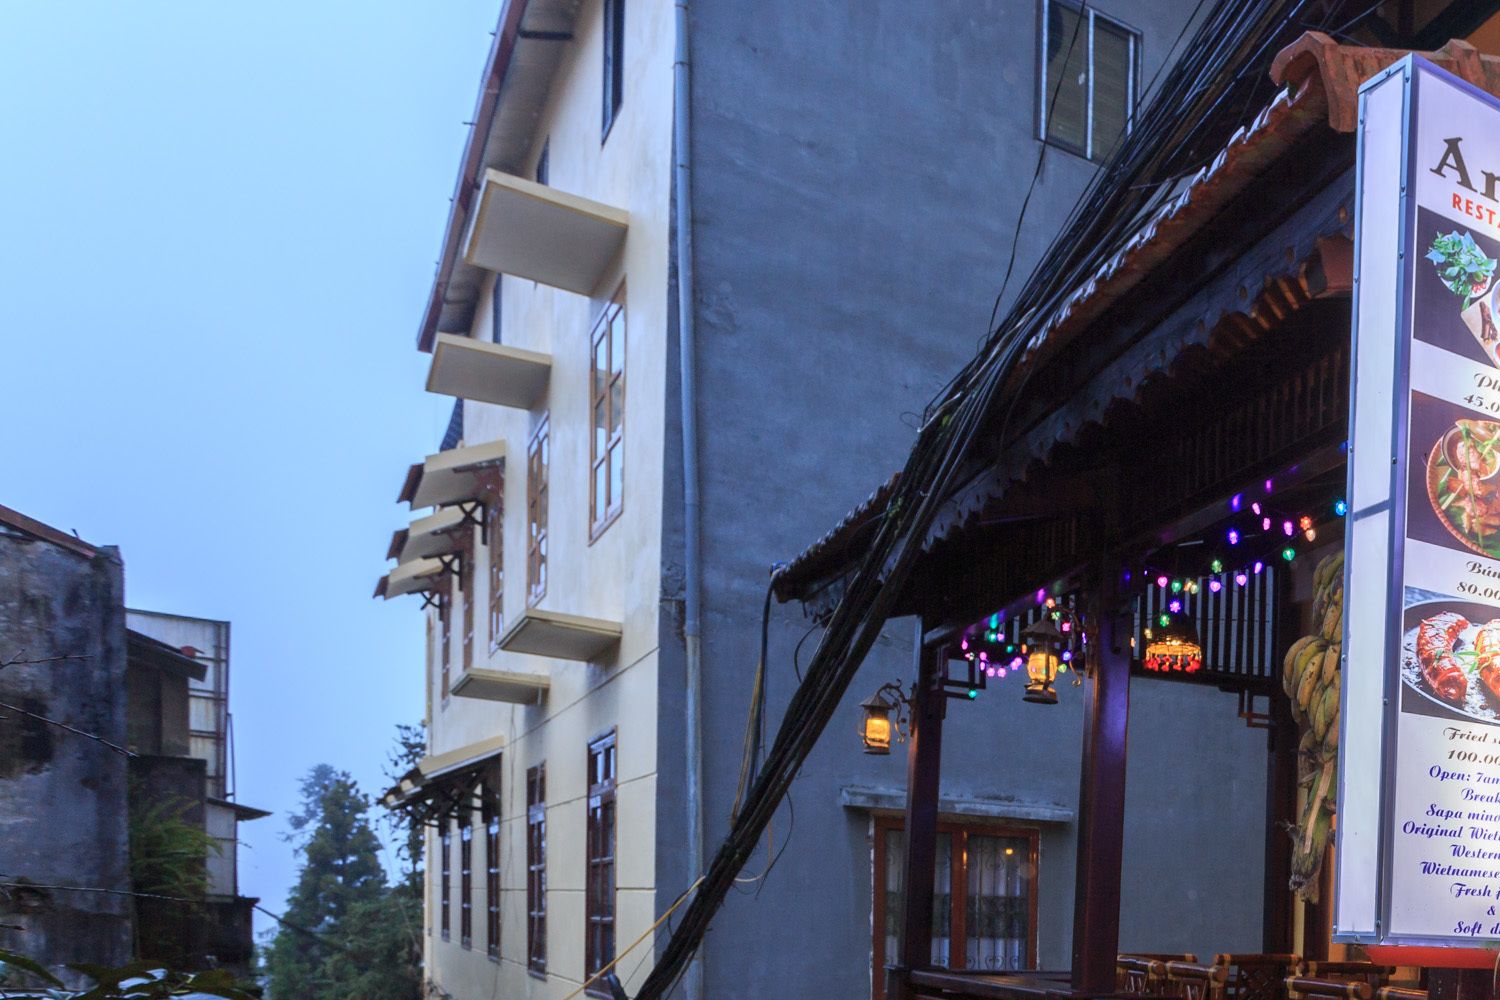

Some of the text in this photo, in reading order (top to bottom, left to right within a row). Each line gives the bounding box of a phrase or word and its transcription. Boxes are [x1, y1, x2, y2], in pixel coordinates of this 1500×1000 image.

[1443, 727, 1488, 743] Fried
[1429, 765, 1471, 782] Open:
[1425, 804, 1463, 820] Sapa
[1403, 821, 1463, 839] Original
[1450, 882, 1491, 898] Fresh
[1486, 905, 1496, 916] &
[1453, 920, 1482, 936] Soft
